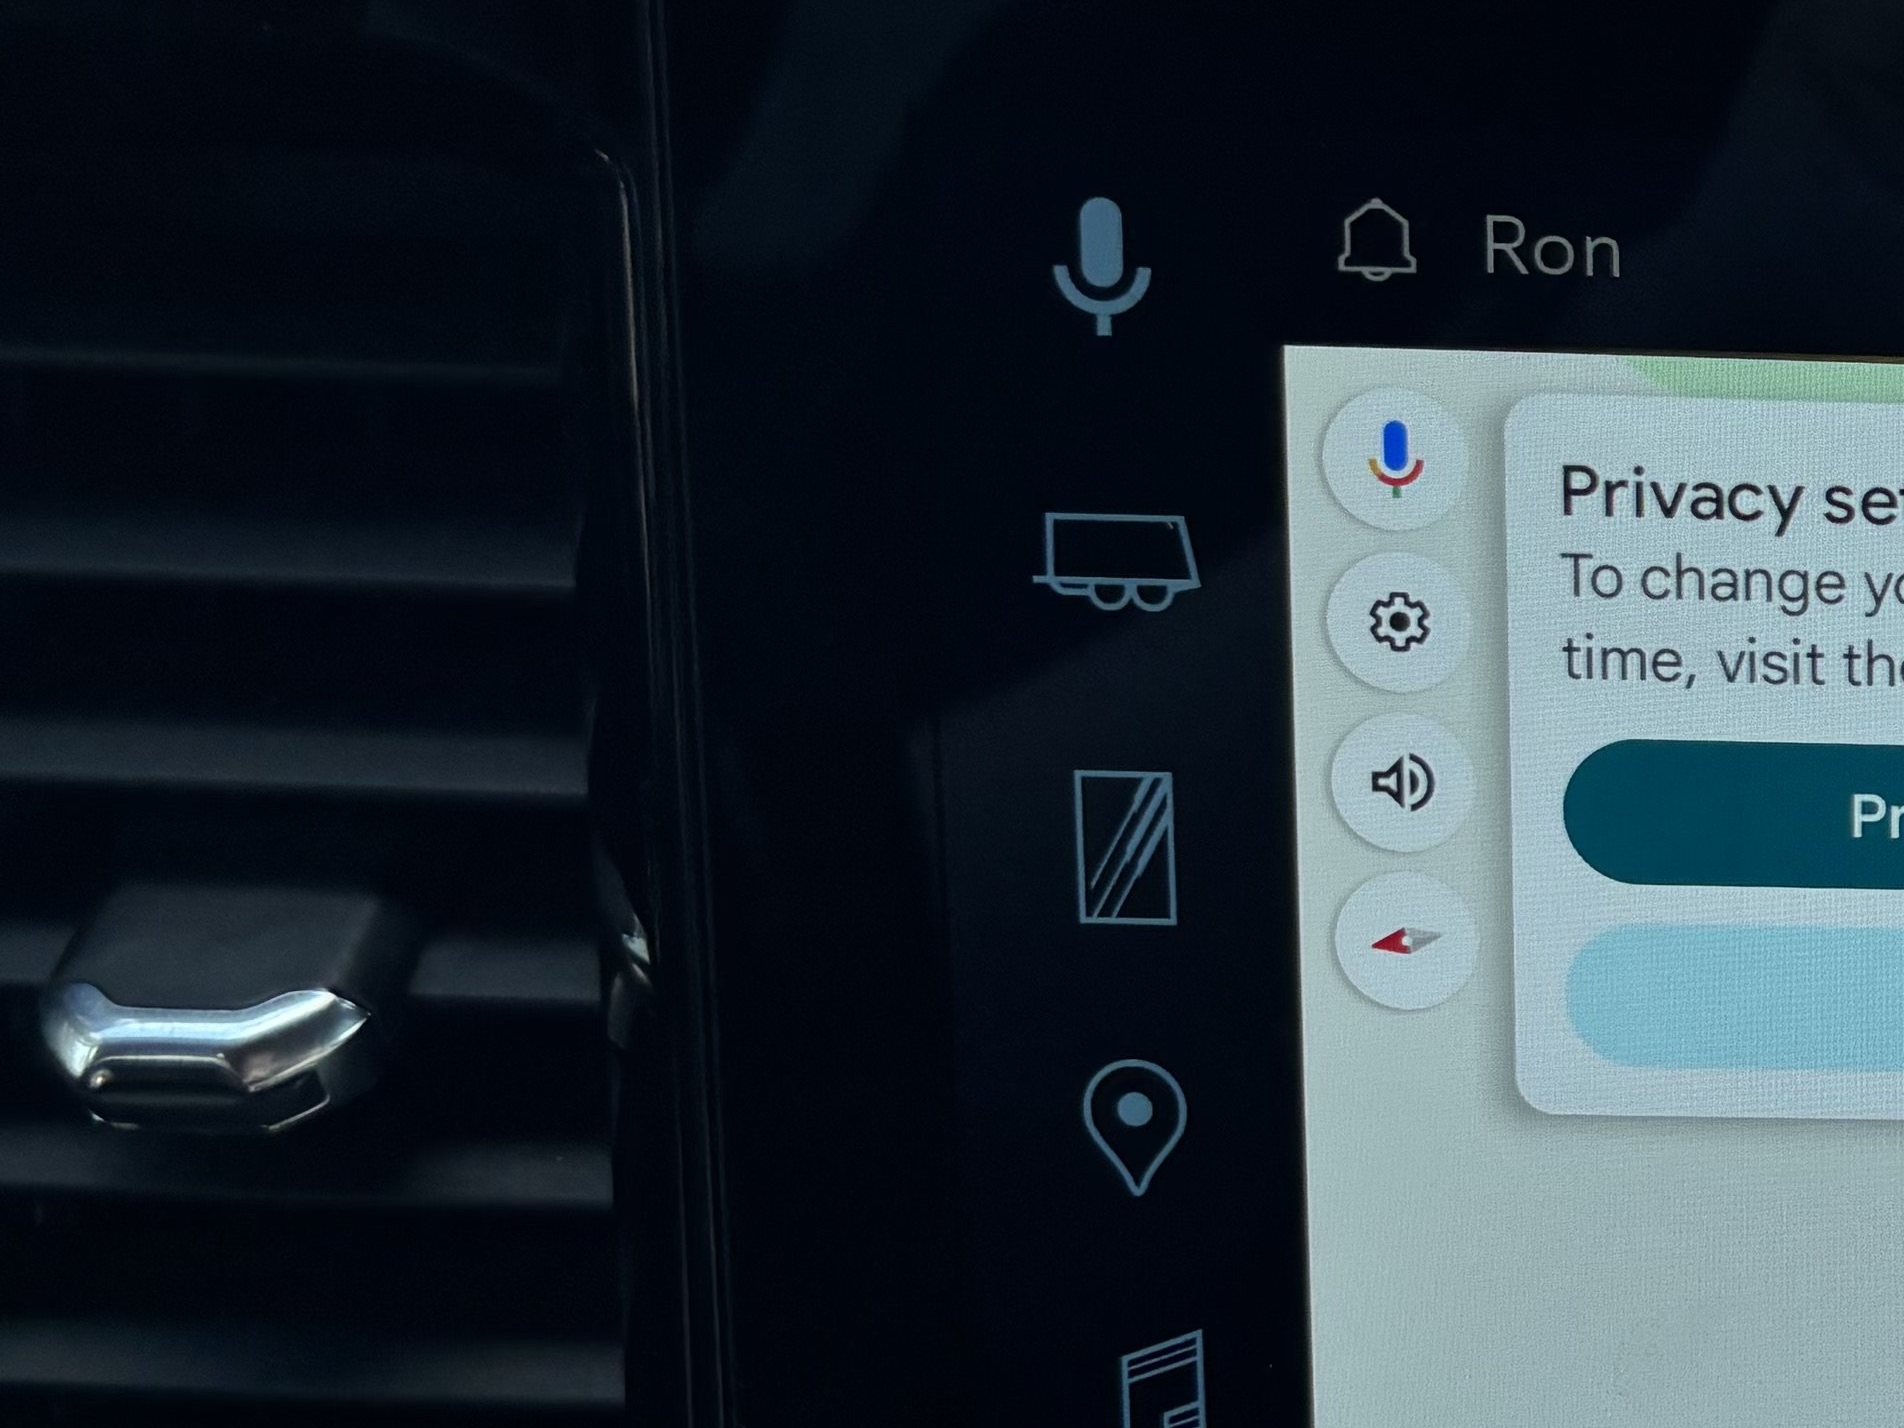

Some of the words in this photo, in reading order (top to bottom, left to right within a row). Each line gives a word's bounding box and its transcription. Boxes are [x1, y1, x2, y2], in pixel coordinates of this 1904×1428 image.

[1483, 215, 1622, 278] Ron
[1560, 465, 1804, 534] Privacy
[1562, 552, 1625, 602] To
[1641, 554, 1847, 617] change
[1562, 636, 1699, 691] time,
[1717, 639, 1827, 690] visit
